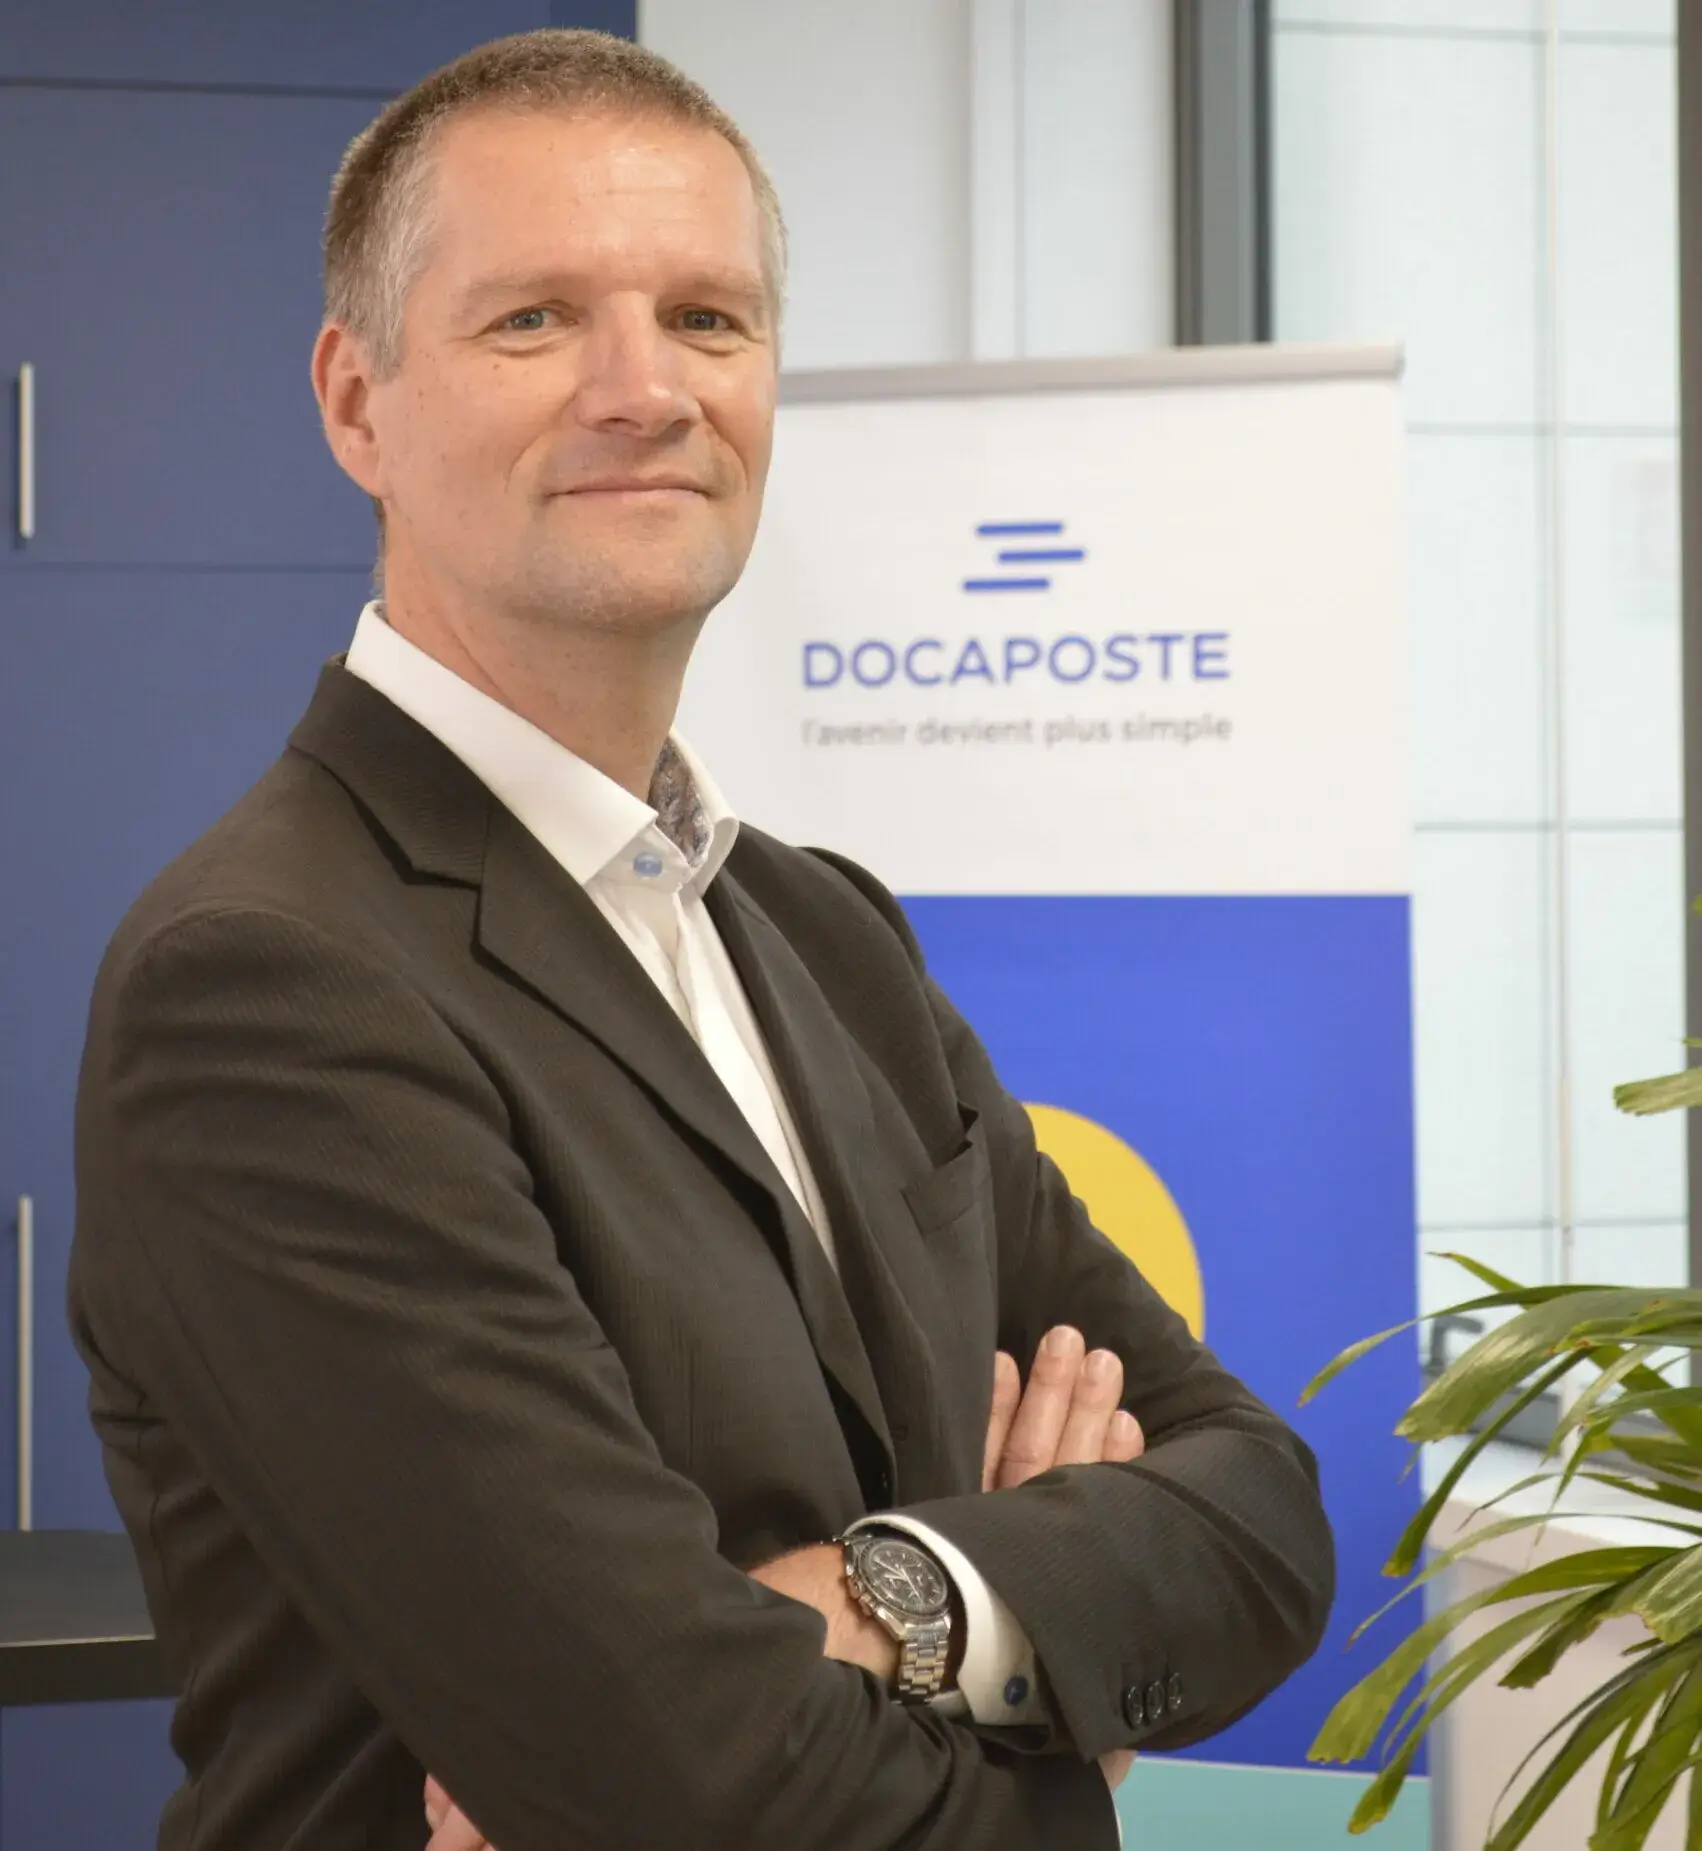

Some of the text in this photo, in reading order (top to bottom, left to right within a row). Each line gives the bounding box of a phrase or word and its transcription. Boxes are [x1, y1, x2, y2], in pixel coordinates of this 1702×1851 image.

[802, 631, 1231, 688] DOCAPOSTE
[802, 713, 1232, 748] l'avenir devient plus simple
